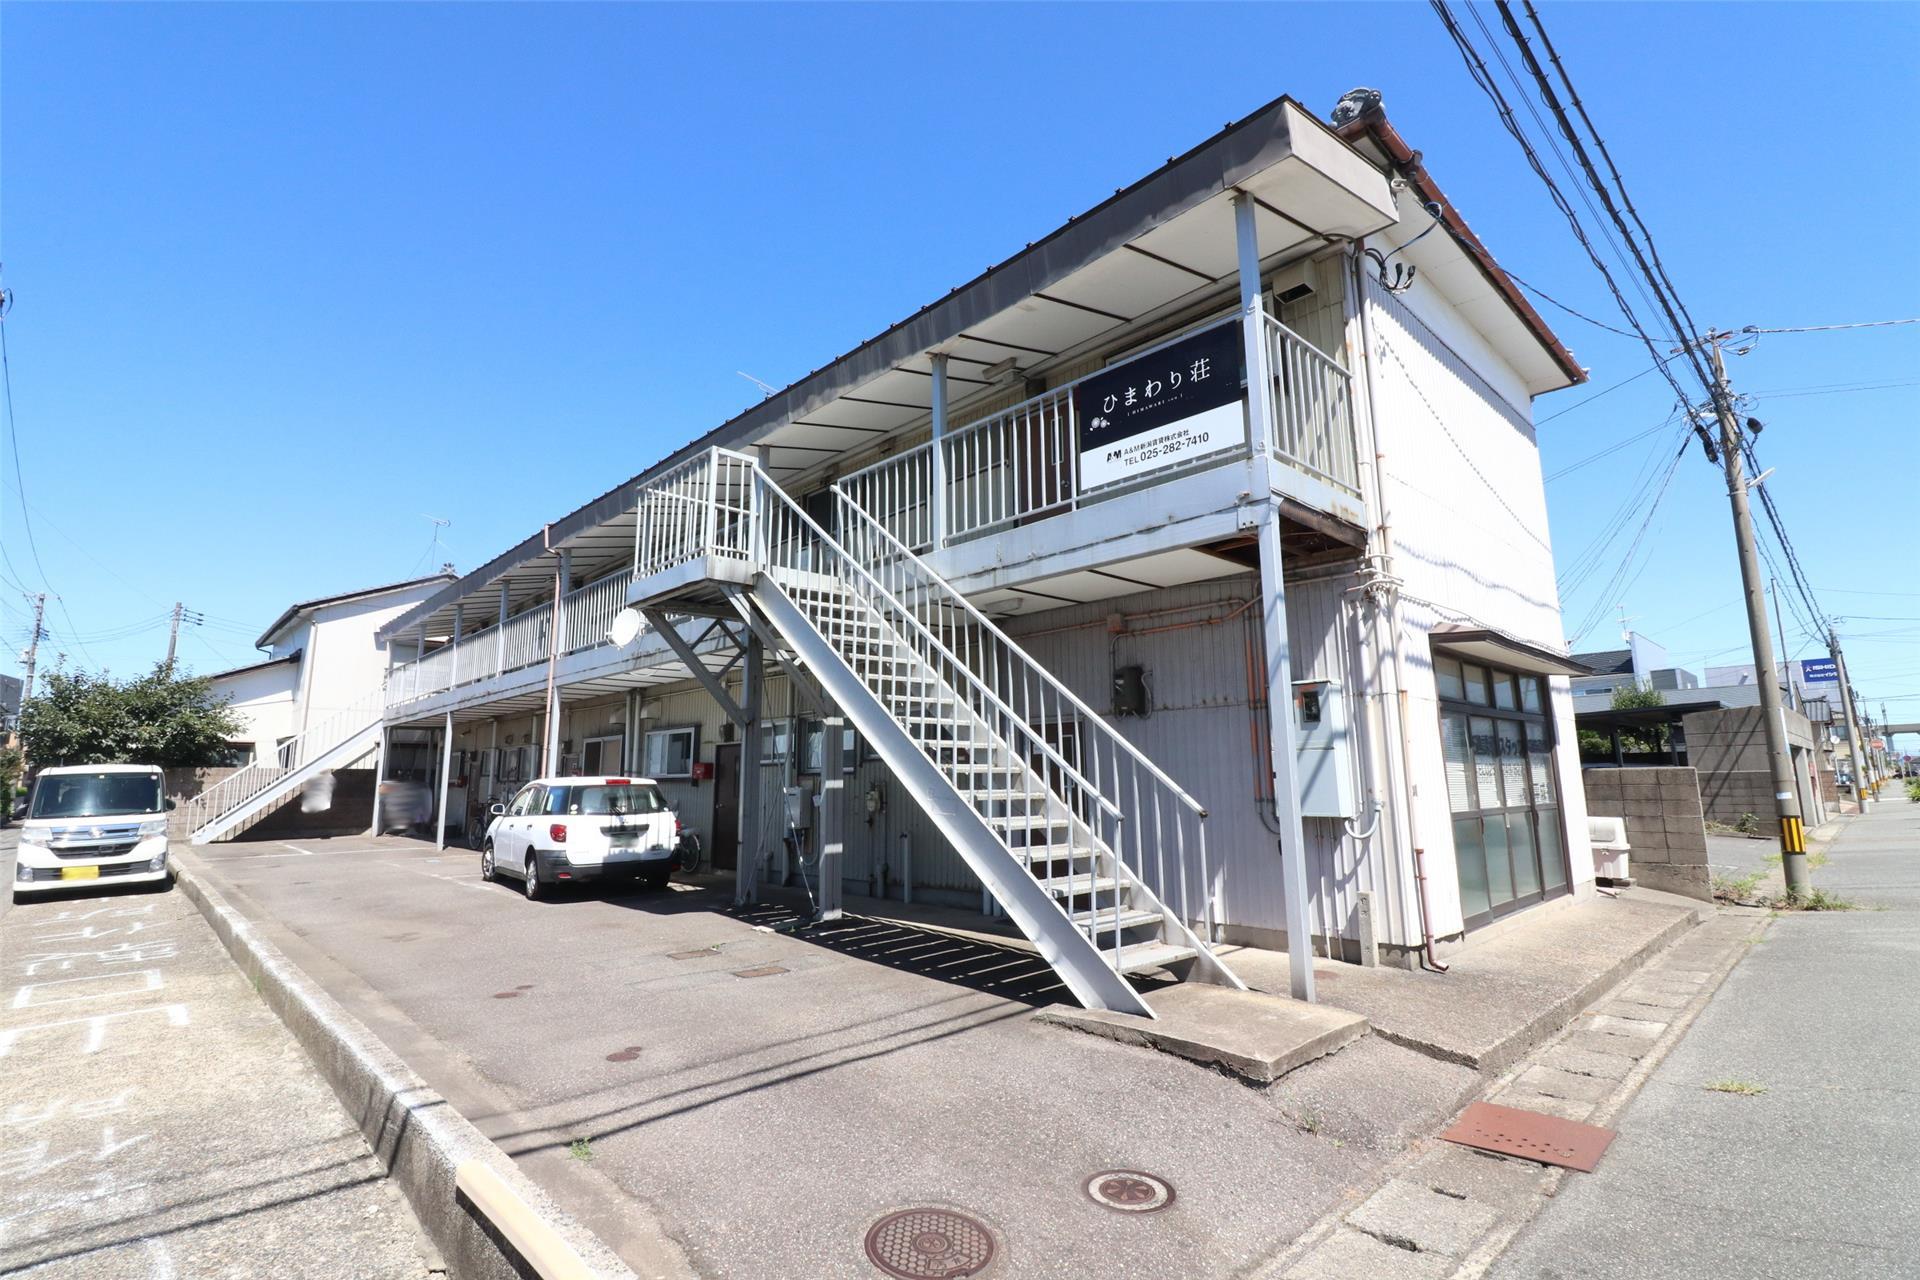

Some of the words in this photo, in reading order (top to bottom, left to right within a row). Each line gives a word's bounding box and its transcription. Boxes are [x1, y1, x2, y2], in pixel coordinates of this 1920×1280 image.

[1103, 358, 1210, 413] ひまわり荘
[1124, 456, 1139, 467] TEL
[1140, 432, 1209, 461] 025-282-7410
